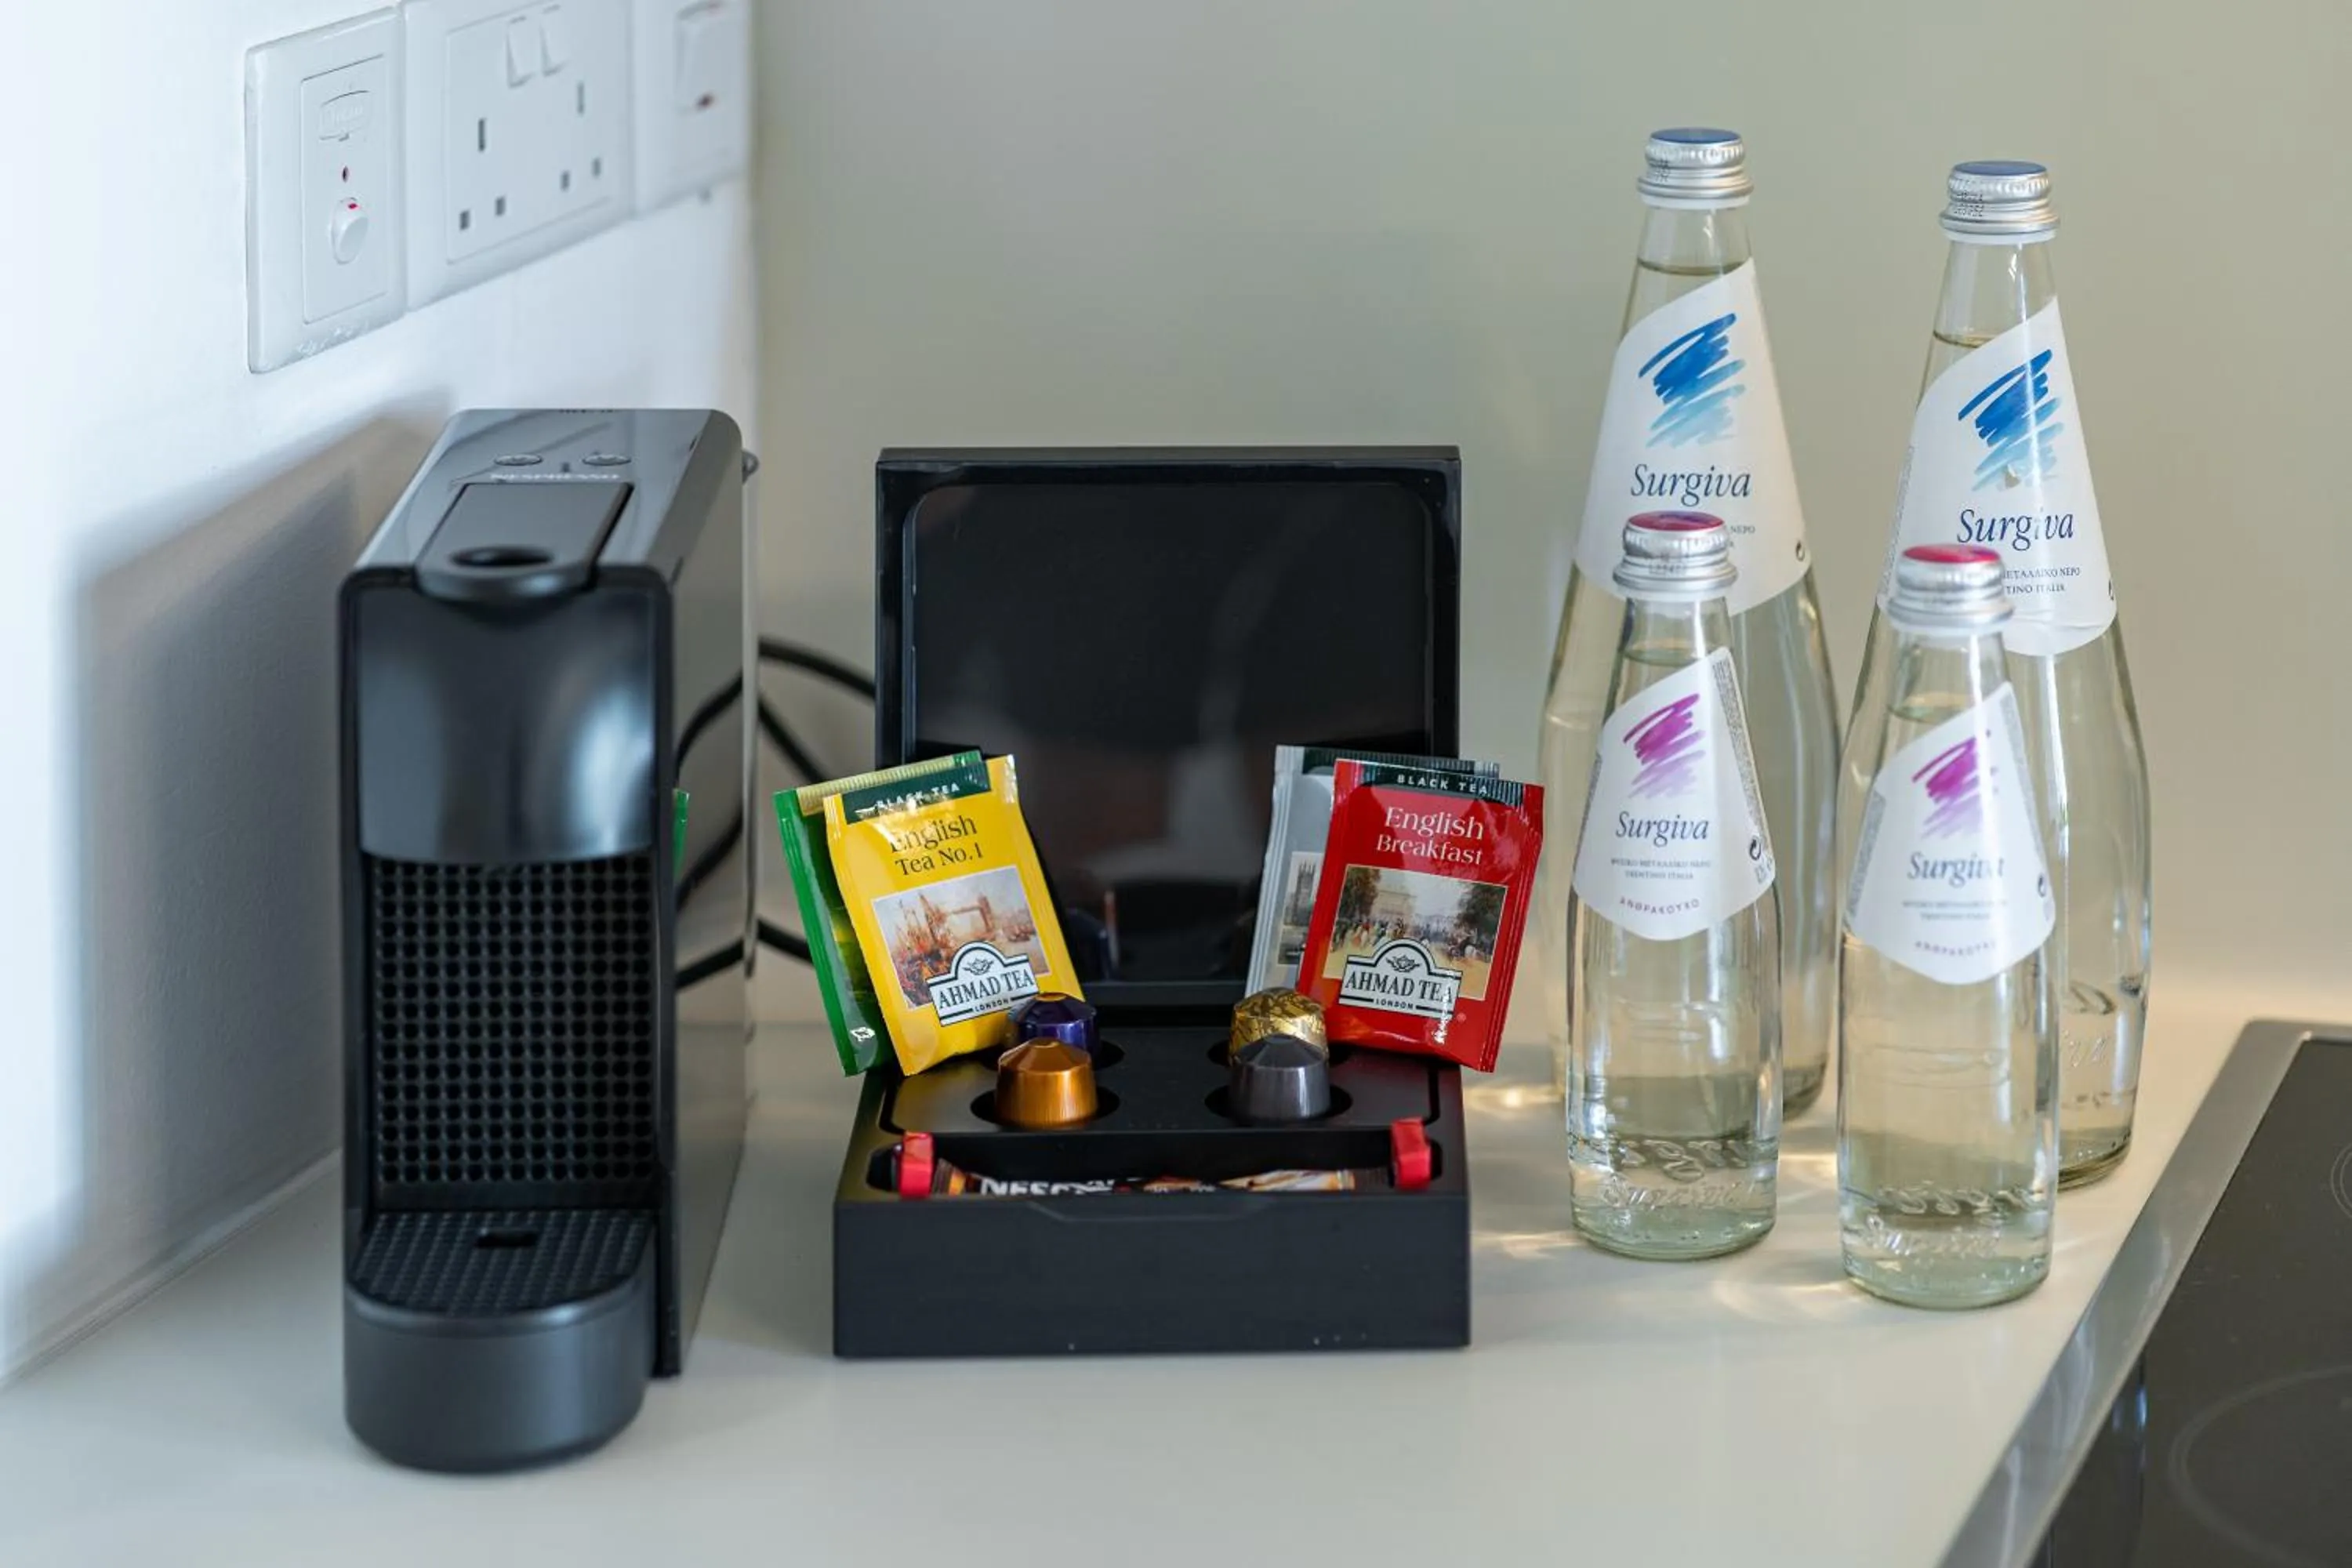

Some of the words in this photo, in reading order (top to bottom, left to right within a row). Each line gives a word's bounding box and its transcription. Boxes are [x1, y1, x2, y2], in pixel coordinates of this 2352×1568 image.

[1630, 463, 1751, 507] Surgiva
[1956, 506, 2074, 552] Surgiva
[931, 782, 960, 797] TEA
[1396, 774, 1449, 791] BLACK
[1458, 782, 1488, 797] TEA
[1385, 806, 1484, 840] English
[1615, 810, 1709, 848] Surgiva
[1376, 833, 1483, 865] Breakfast
[895, 855, 935, 876] Tea
[939, 976, 1001, 1010] AHMAD
[1000, 968, 1035, 992] TEA
[1345, 971, 1415, 996] AHMAD
[1418, 979, 1454, 1004] TEA
[974, 999, 1009, 1012] LONDON
[1375, 998, 1414, 1011] LONDON
